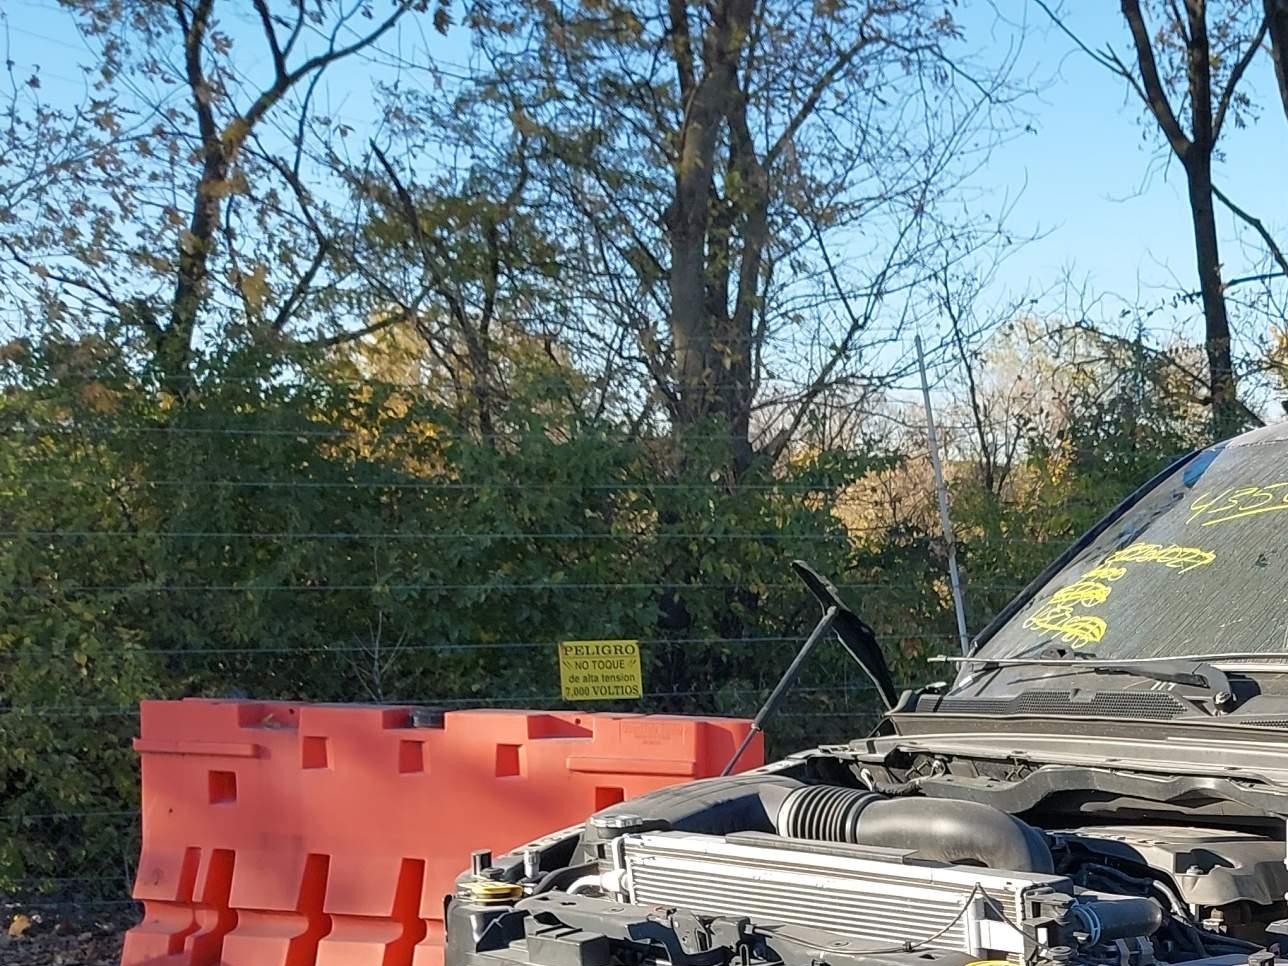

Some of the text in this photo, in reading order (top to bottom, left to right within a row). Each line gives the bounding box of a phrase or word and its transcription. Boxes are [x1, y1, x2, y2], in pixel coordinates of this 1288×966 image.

[564, 644, 636, 656] PELIGRO
[575, 659, 625, 670] NO TOQUE
[568, 674, 580, 683] de
[582, 673, 599, 683] alta
[565, 684, 640, 697] 7,000 VOLTIOS
